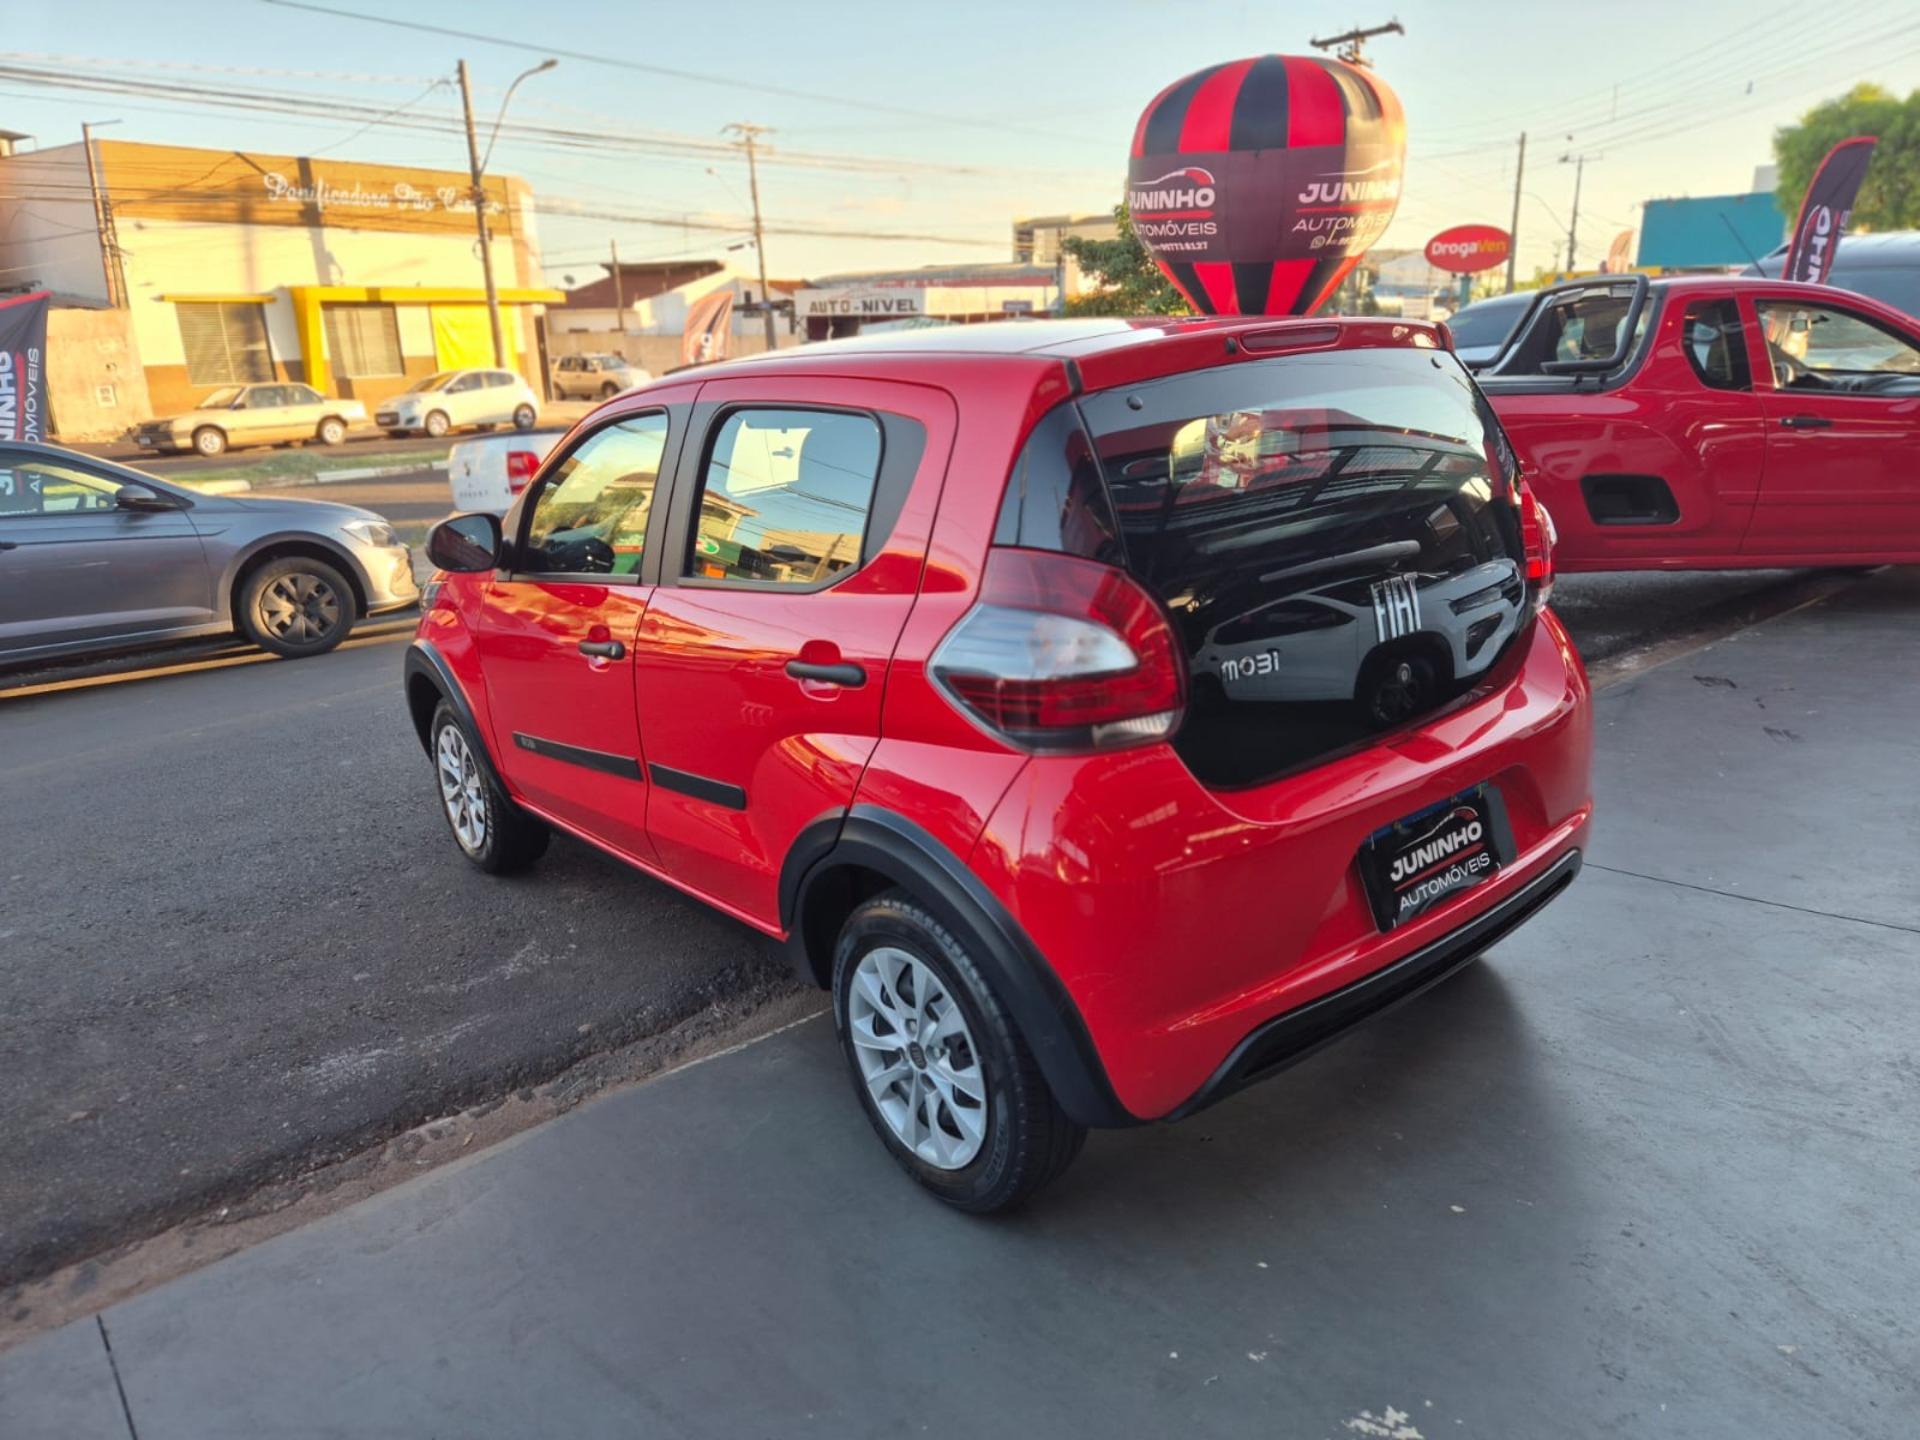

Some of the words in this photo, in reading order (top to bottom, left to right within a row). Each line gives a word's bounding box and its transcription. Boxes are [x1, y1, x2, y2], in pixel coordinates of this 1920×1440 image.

[263, 172, 390, 212] Panificadora
[1432, 239, 1506, 259] DrogaVen
[1370, 571, 1422, 643] FIAT
[1390, 821, 1483, 882] JUNINHO
[1399, 852, 1491, 911] AUTOMÓVEIS
